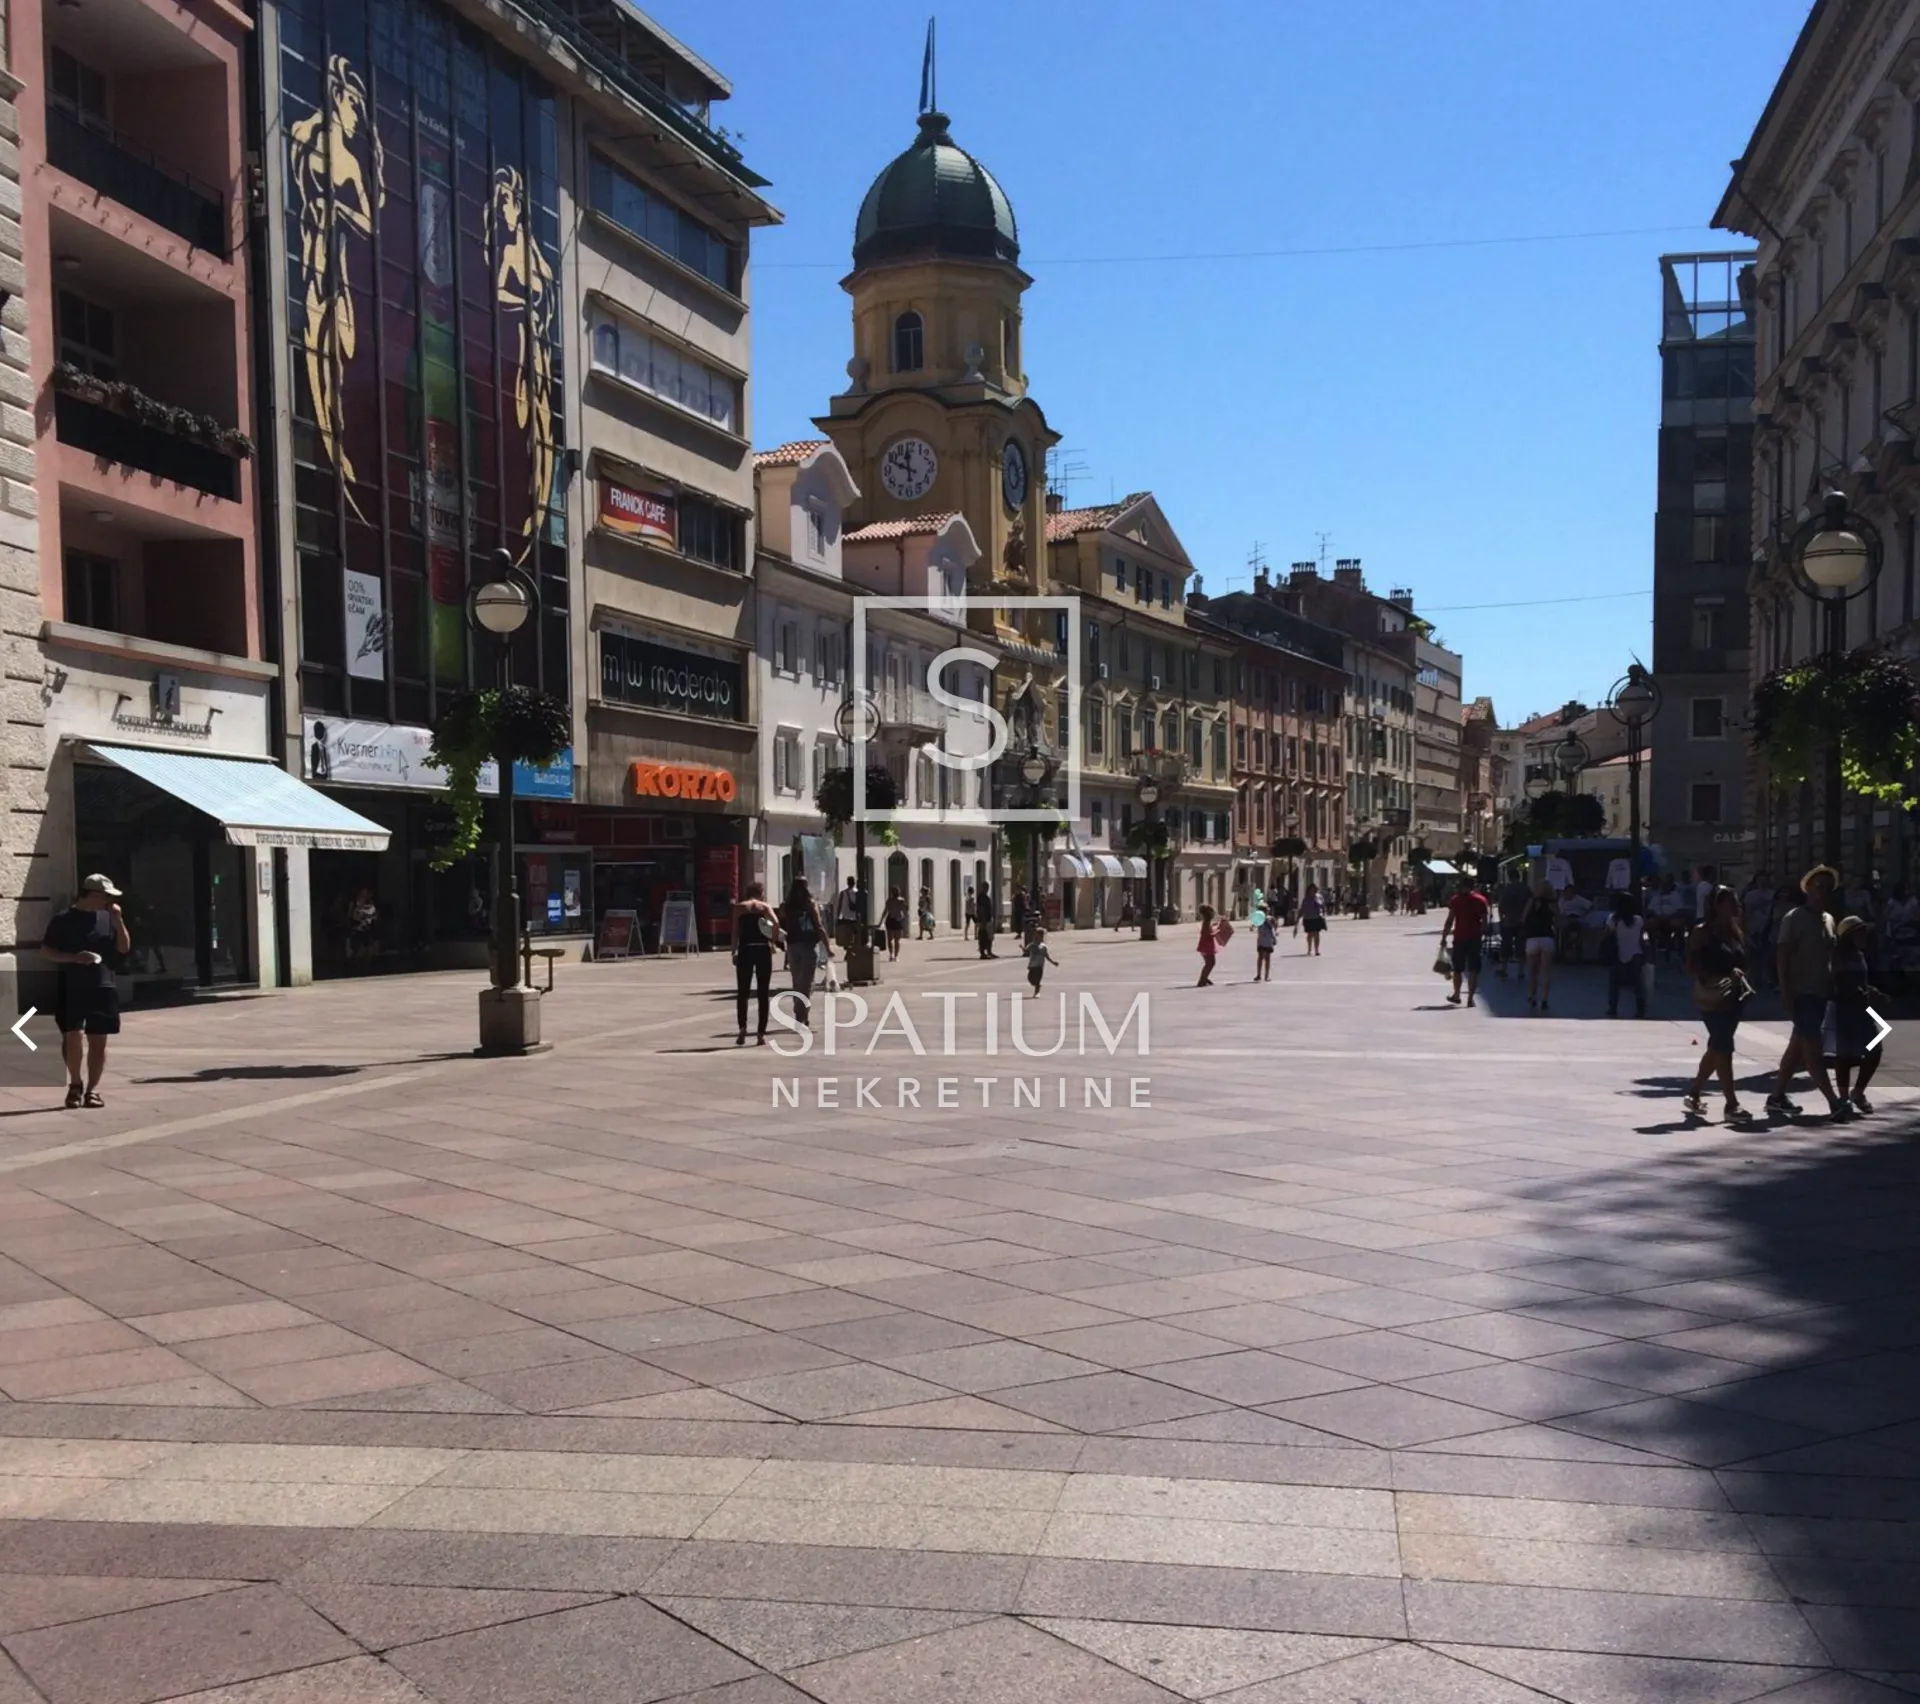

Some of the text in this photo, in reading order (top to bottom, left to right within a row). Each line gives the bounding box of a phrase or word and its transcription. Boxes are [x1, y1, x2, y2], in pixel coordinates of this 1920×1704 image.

[610, 487, 667, 525] FRANCK CAFÉ
[651, 664, 730, 705] moderato
[634, 761, 737, 803] KORZO
